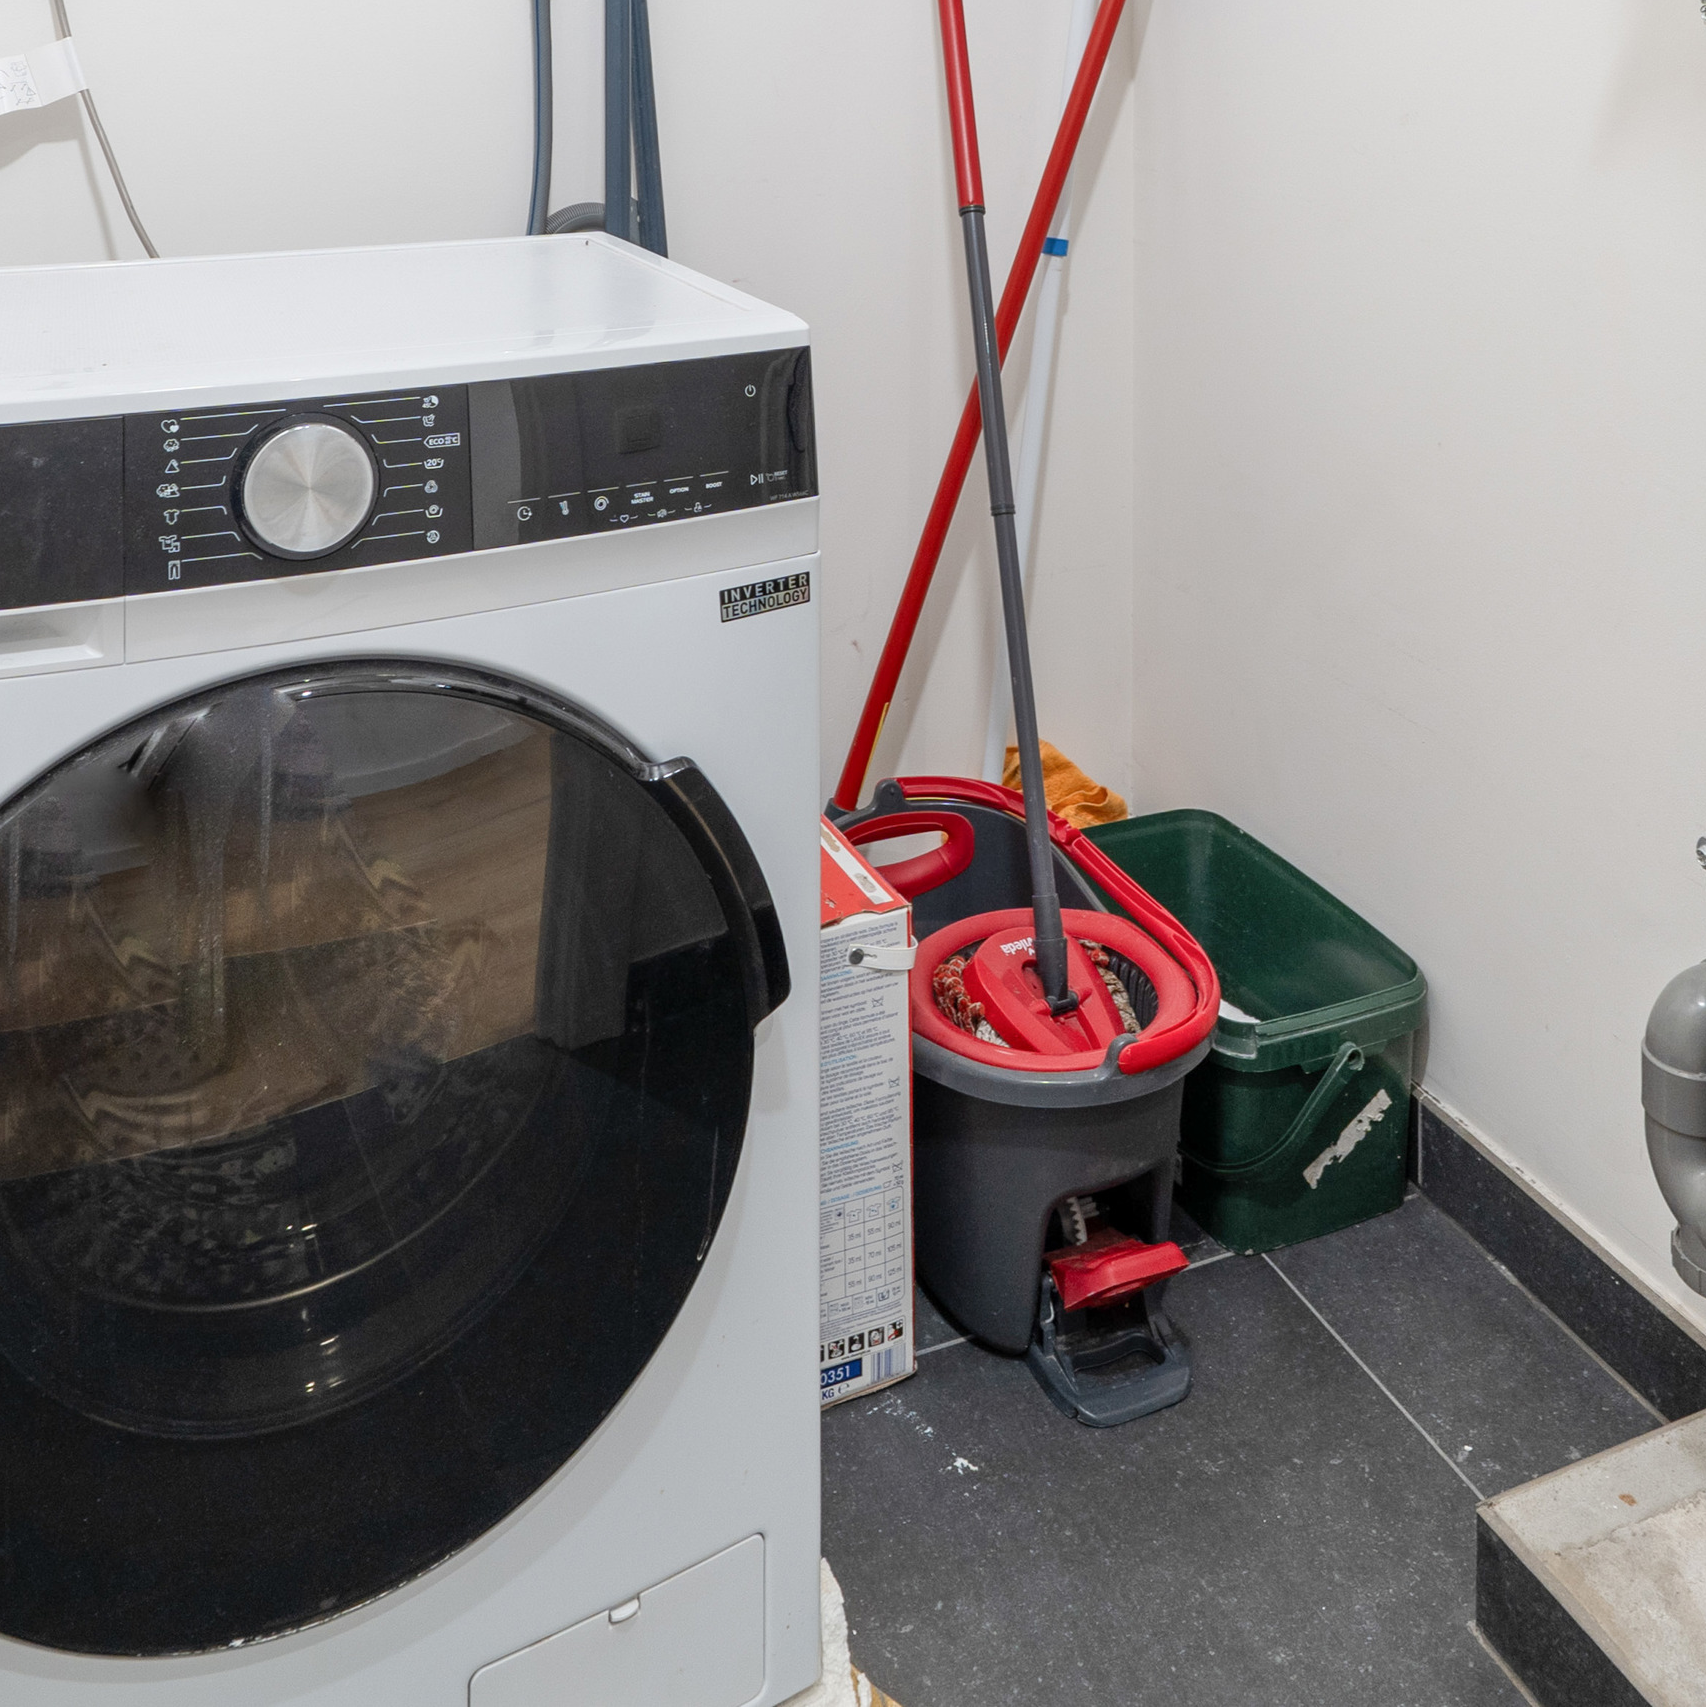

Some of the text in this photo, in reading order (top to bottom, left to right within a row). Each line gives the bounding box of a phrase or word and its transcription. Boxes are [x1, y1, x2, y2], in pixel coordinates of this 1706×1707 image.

[669, 486, 689, 494] OPTION
[705, 481, 723, 489] BOOST
[631, 496, 654, 505] MASTER
[723, 573, 808, 604] INVERTER
[723, 587, 809, 620] TECHNOLOGY
[821, 1388, 835, 1401] KG
